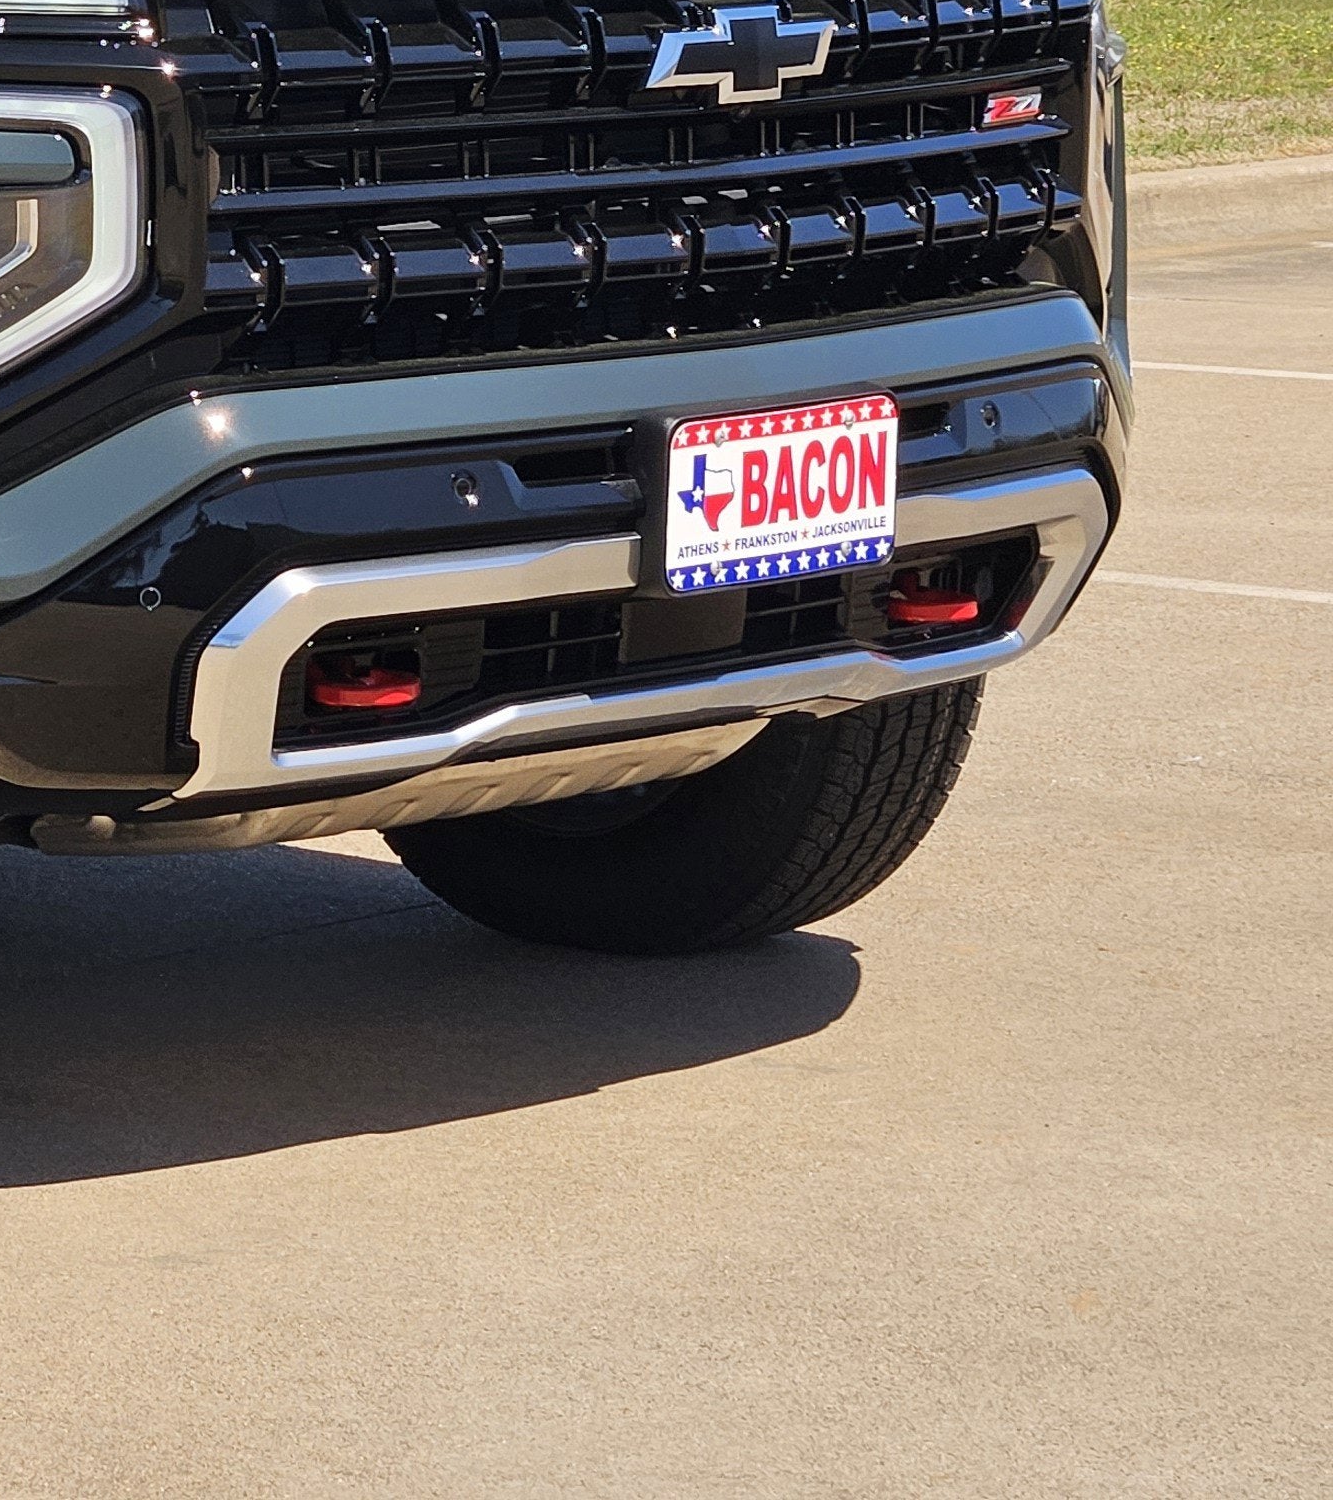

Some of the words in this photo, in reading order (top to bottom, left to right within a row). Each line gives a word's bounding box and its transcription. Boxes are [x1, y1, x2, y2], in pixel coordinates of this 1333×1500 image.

[982, 93, 1042, 124] Z71
[740, 430, 887, 528] BACON
[677, 541, 720, 560] ATHENS
[734, 530, 799, 551] FRANKSTON
[811, 516, 887, 539] JACKSONVILLE
